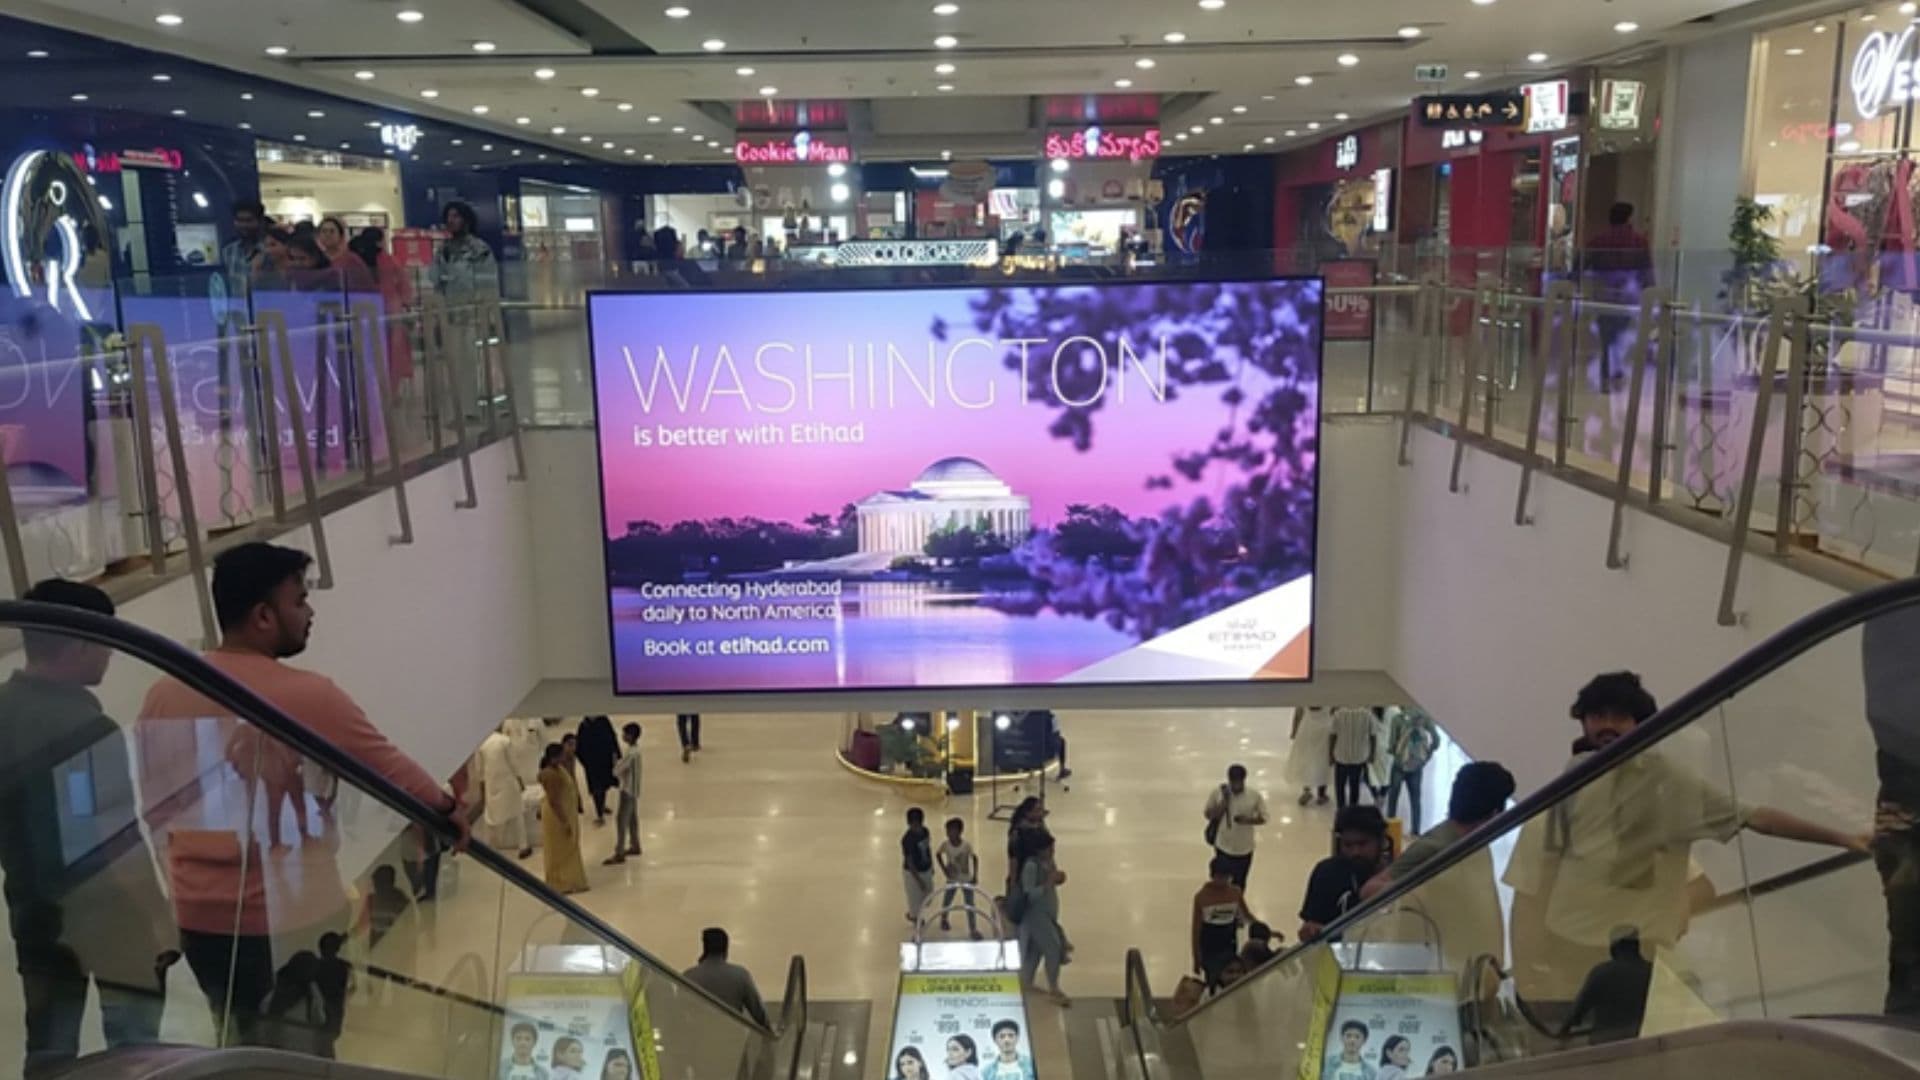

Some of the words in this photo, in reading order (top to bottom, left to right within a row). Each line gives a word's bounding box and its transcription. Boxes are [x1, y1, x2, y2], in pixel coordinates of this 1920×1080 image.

[736, 141, 796, 161] Cookie
[808, 141, 849, 161] Man
[622, 335, 1167, 414] WASHINGTON
[634, 424, 651, 446] is
[658, 424, 729, 446] better
[735, 423, 784, 444] with
[791, 421, 864, 443] Etihad
[641, 581, 741, 600] Connecting
[745, 579, 842, 599] Hyderabad
[642, 604, 685, 624] daily
[689, 606, 707, 621] to
[712, 604, 760, 620] North
[764, 602, 839, 619] America
[643, 637, 691, 656] Book
[696, 639, 714, 655] at
[720, 635, 829, 655] etihad.com
[920, 984, 960, 993] LOWER
[965, 983, 1003, 993] PRICES
[936, 997, 989, 1008] TRENDS
